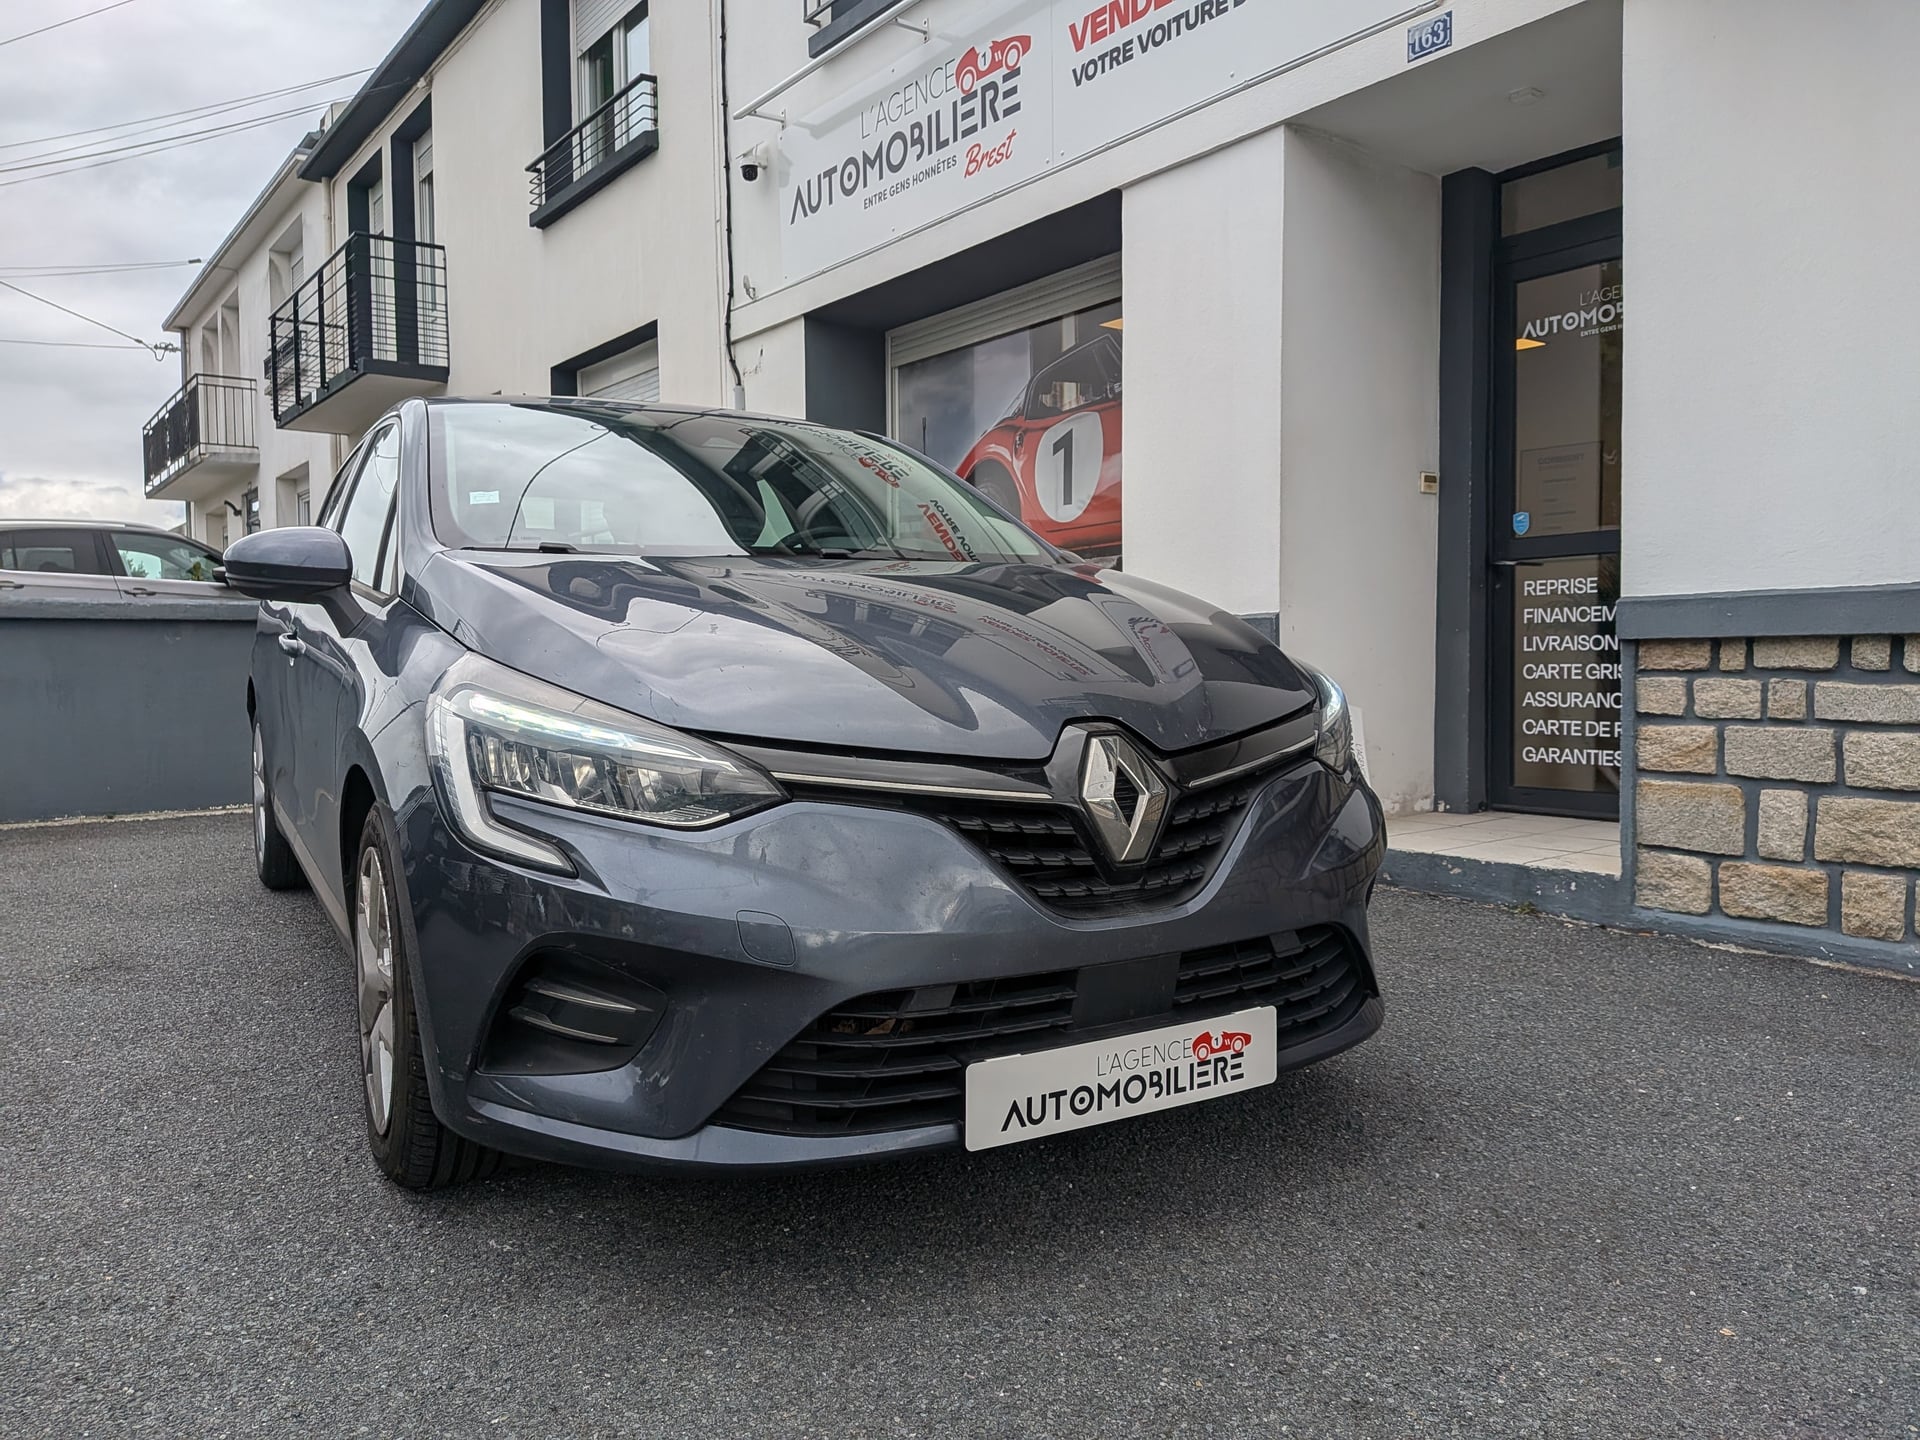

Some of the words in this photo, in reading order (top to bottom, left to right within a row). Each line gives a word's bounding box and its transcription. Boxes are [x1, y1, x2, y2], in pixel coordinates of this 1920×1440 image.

[1071, 38, 1134, 87] VOTRE
[1136, 0, 1229, 54] VOITURE
[1414, 21, 1444, 52] 163
[860, 58, 956, 140] L'AGENCE
[964, 128, 1017, 179] Brest
[863, 190, 888, 210] ENTRE
[889, 177, 911, 197] GENS
[911, 155, 958, 186] HONNÊTES
[1580, 284, 1623, 306] L'AGE
[1052, 427, 1073, 506] 1
[1523, 577, 1598, 596] REPRISE
[1523, 634, 1618, 651] LIVRAISON
[1522, 663, 1582, 680] CARTE
[1522, 692, 1623, 709] ASSURANC
[1522, 719, 1582, 736] CARTE
[1585, 720, 1611, 737] DE
[1522, 747, 1623, 767] GARANTIES
[1096, 1037, 1193, 1077] L'AGENCE
